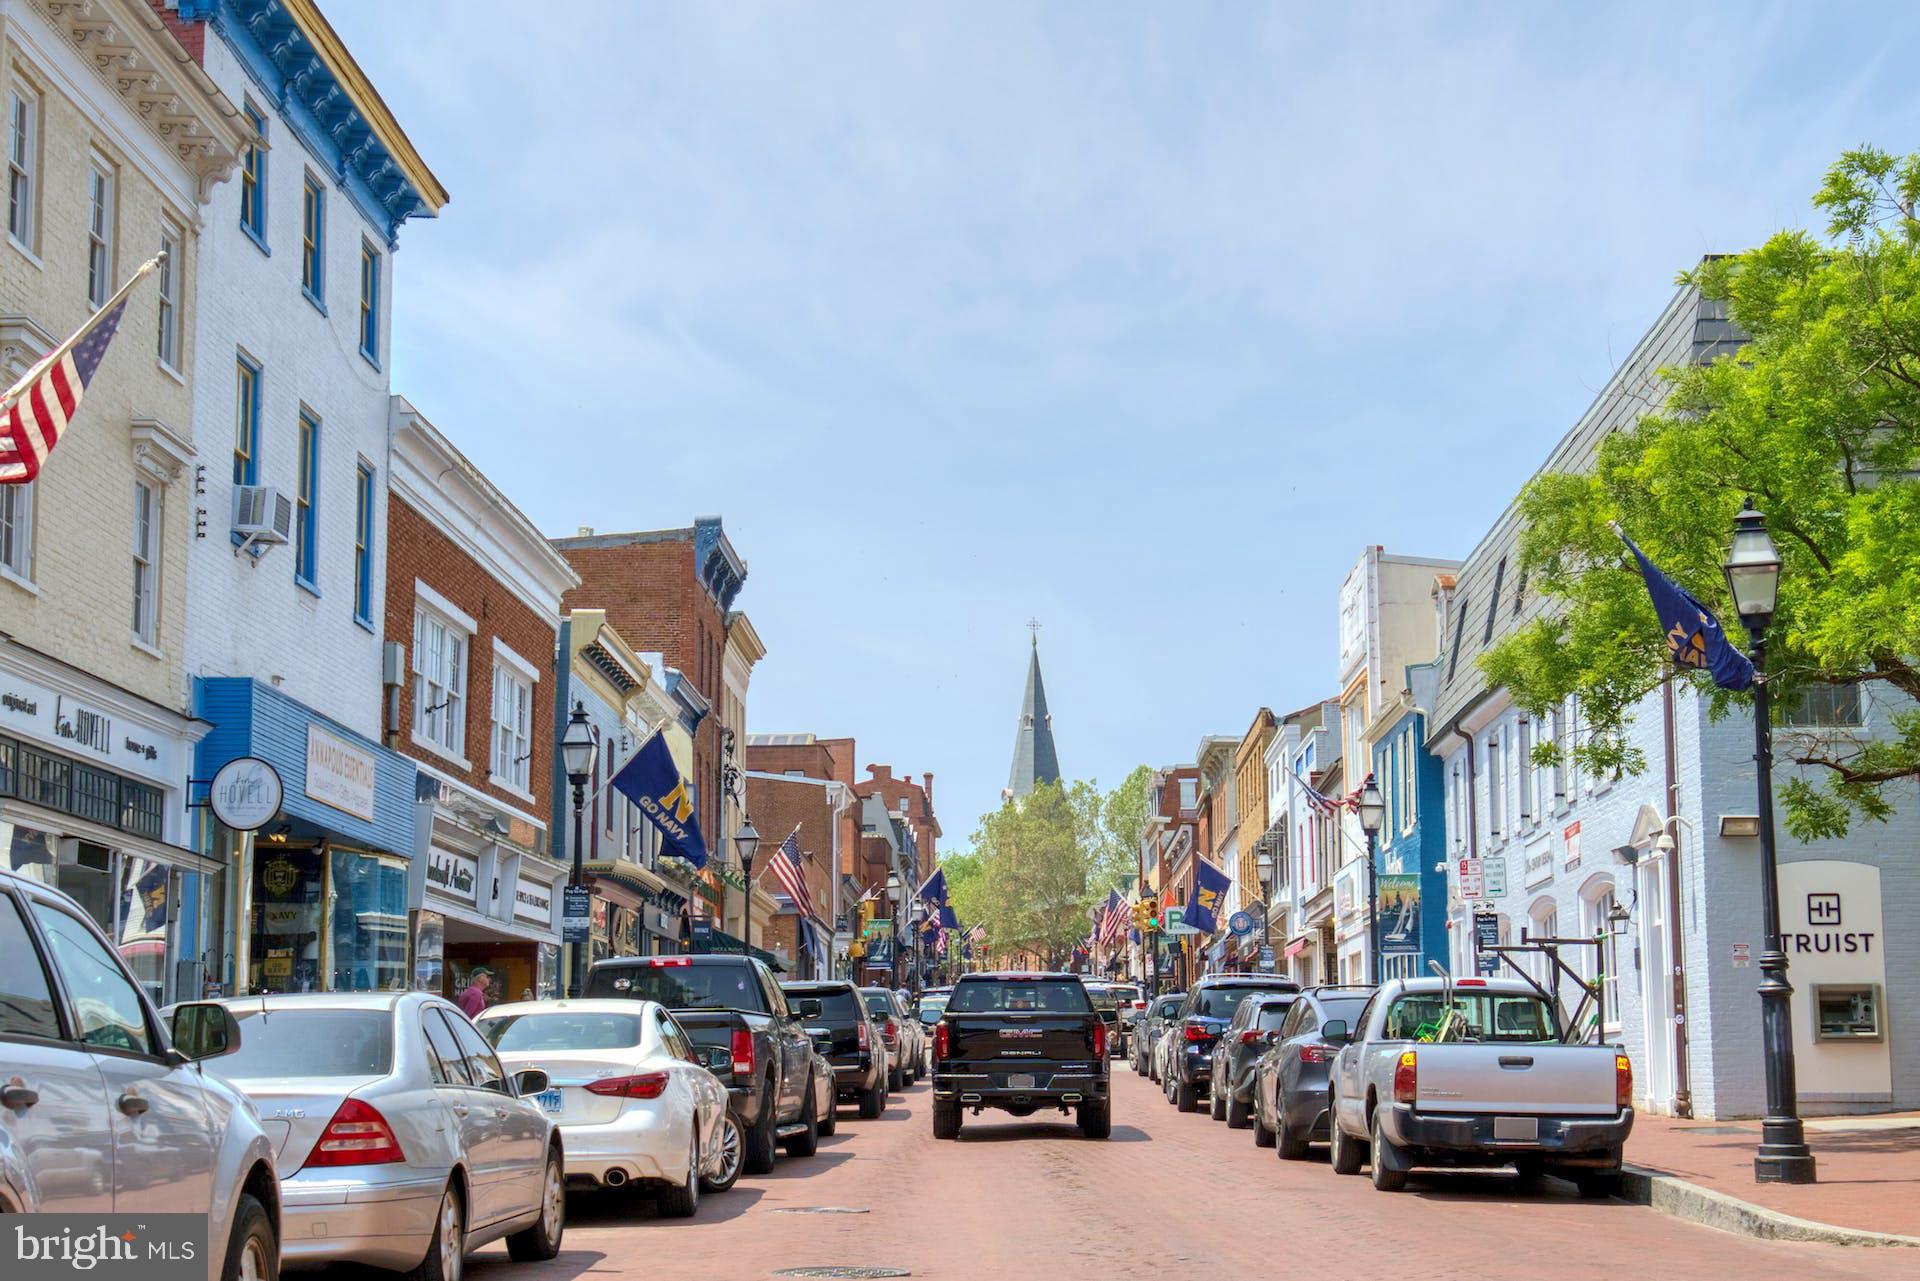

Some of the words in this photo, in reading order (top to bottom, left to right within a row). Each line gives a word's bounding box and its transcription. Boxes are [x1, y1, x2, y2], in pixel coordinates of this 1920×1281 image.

[76, 708, 112, 755] HOVELL
[219, 783, 273, 804] HOVELL
[639, 795, 659, 814] GO
[655, 811, 689, 840] NAVY
[1380, 877, 1416, 889] Welcome
[270, 911, 297, 920] NAVY
[1780, 932, 1875, 953] TRUIST
[999, 1029, 1042, 1038] GMC
[273, 1109, 305, 1119] AMG
